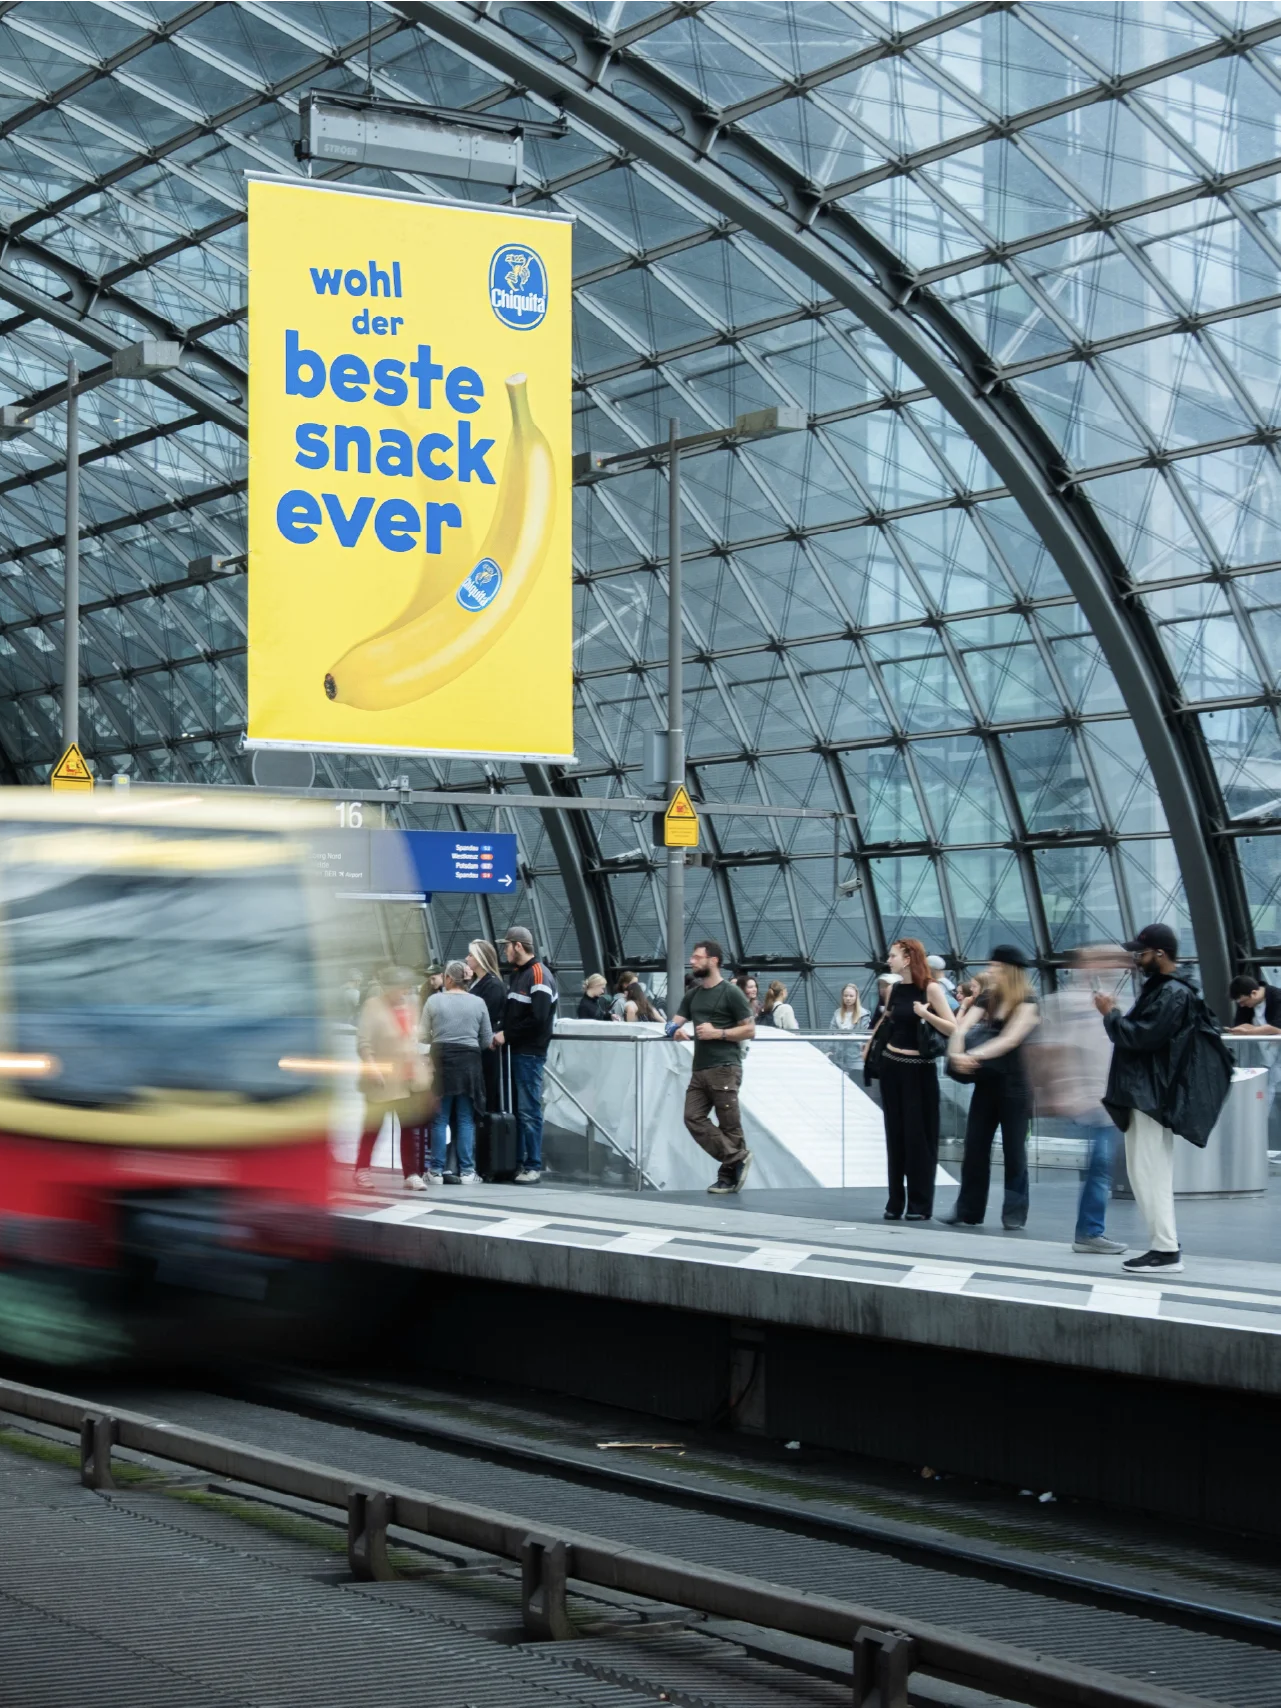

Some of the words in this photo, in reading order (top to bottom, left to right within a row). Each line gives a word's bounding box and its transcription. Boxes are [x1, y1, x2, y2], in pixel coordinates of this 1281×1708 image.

[309, 260, 402, 298] wohl
[491, 288, 546, 316] Chiquita
[352, 308, 404, 335] der
[285, 329, 485, 414] beste
[295, 420, 496, 484] snack
[276, 489, 462, 555] ever
[335, 801, 363, 829] 16
